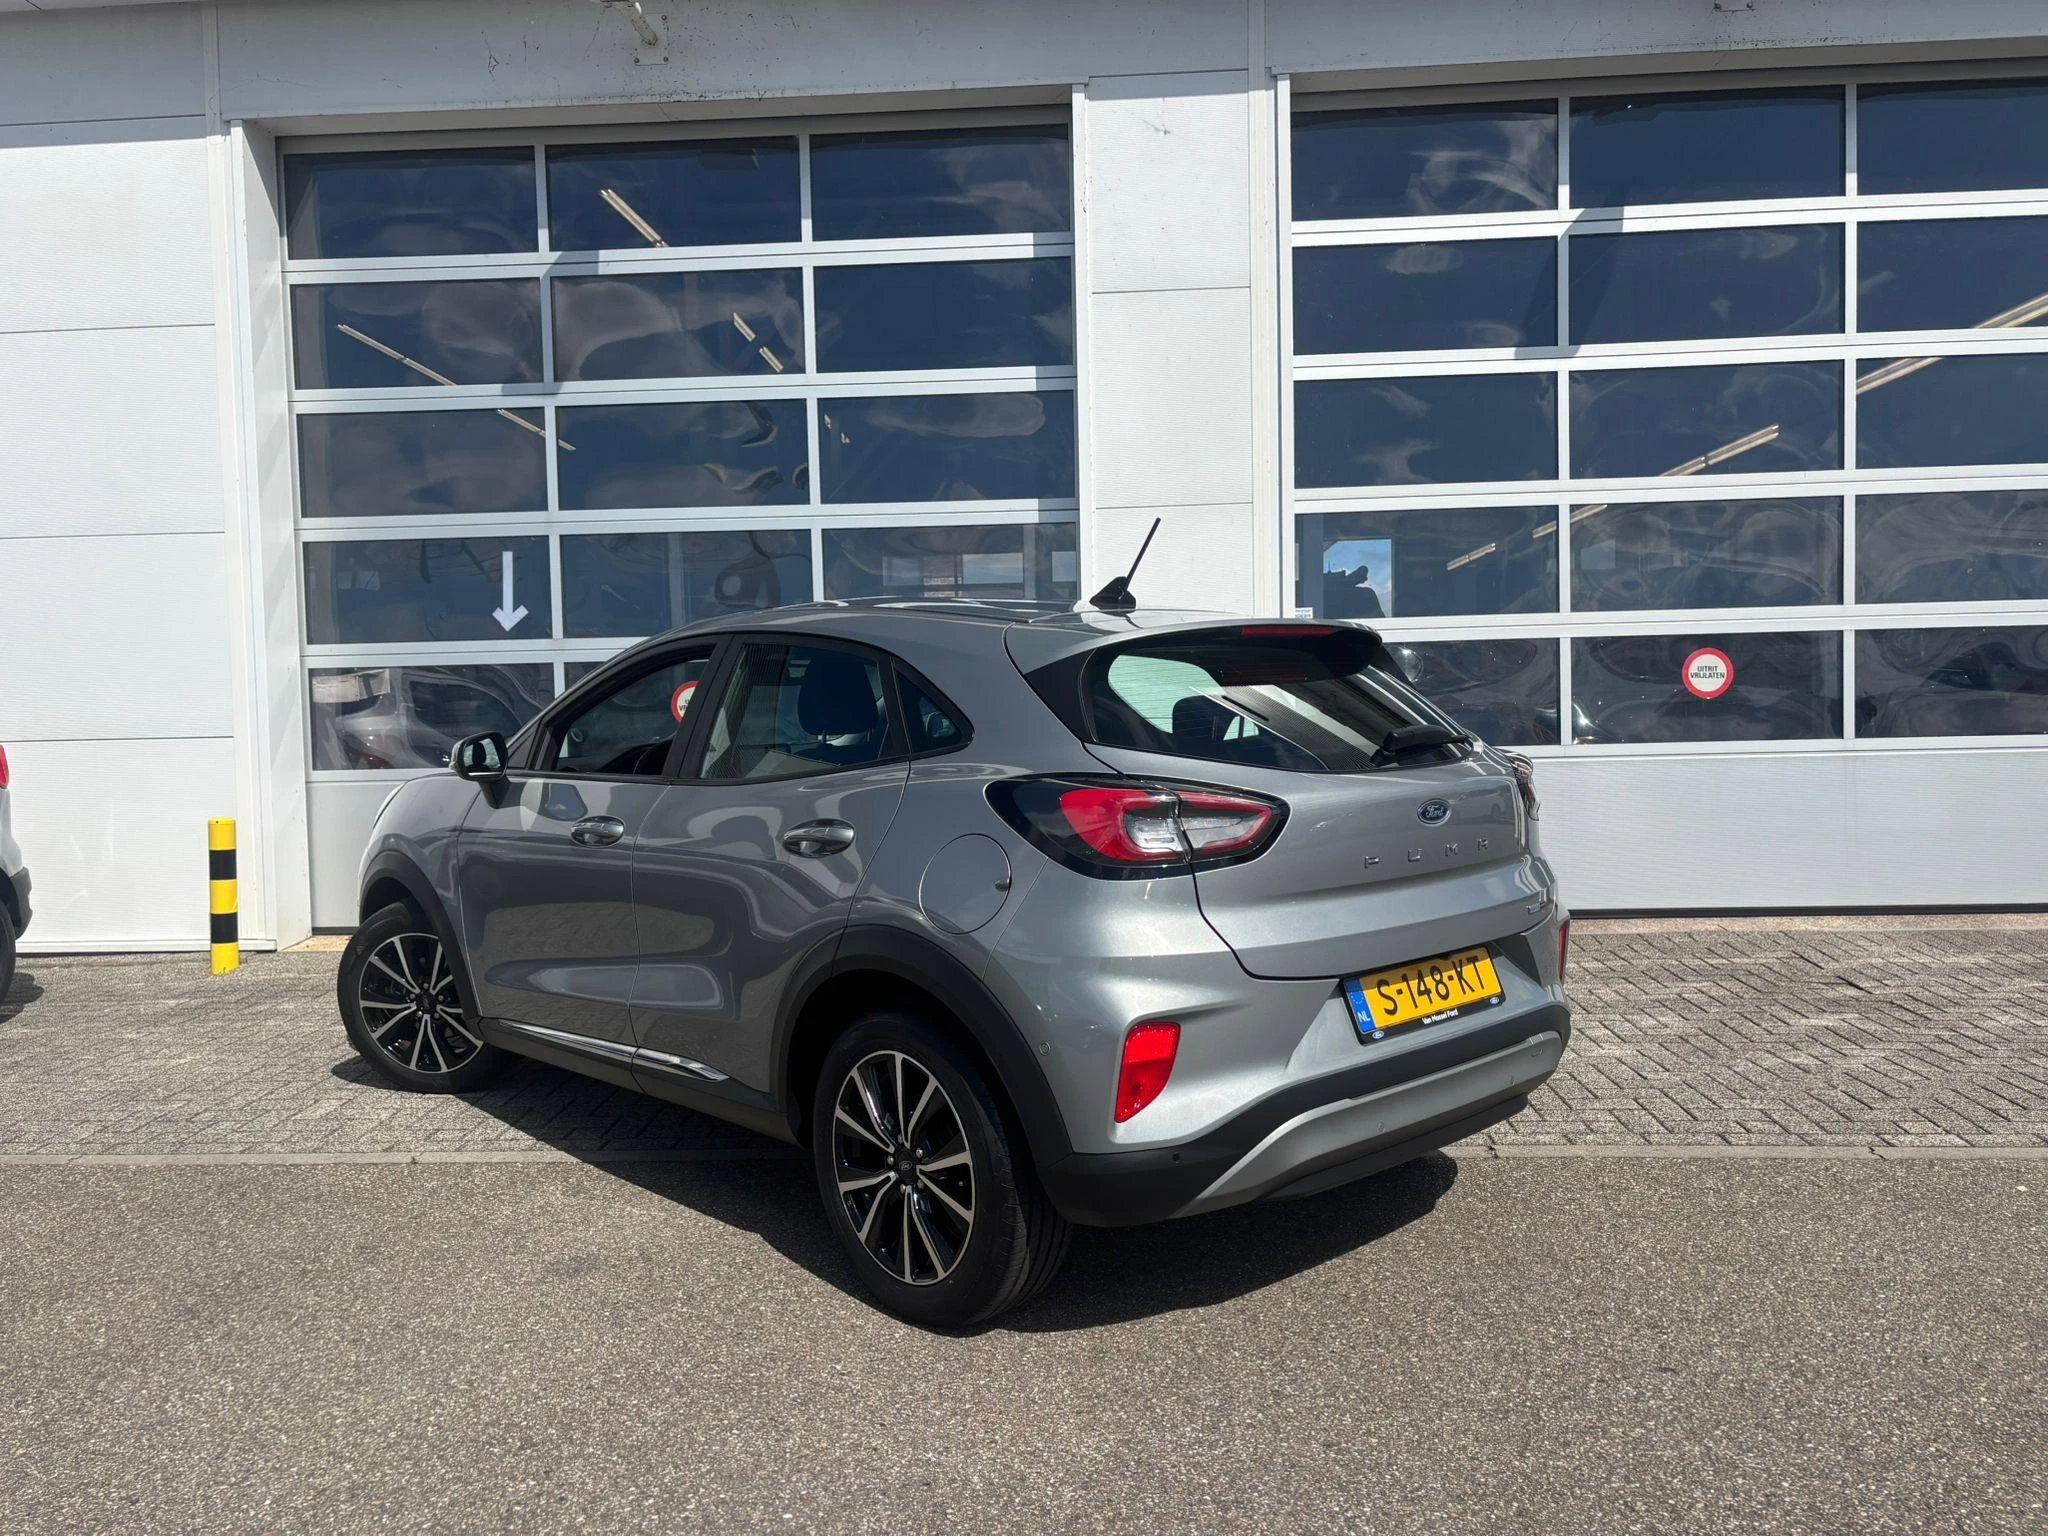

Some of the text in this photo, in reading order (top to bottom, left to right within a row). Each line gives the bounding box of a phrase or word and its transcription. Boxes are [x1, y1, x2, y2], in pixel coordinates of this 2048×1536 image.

[1364, 838, 1488, 869] PUMA
[1376, 955, 1485, 1016] S-148-KT
[1356, 1010, 1371, 1023] NL
